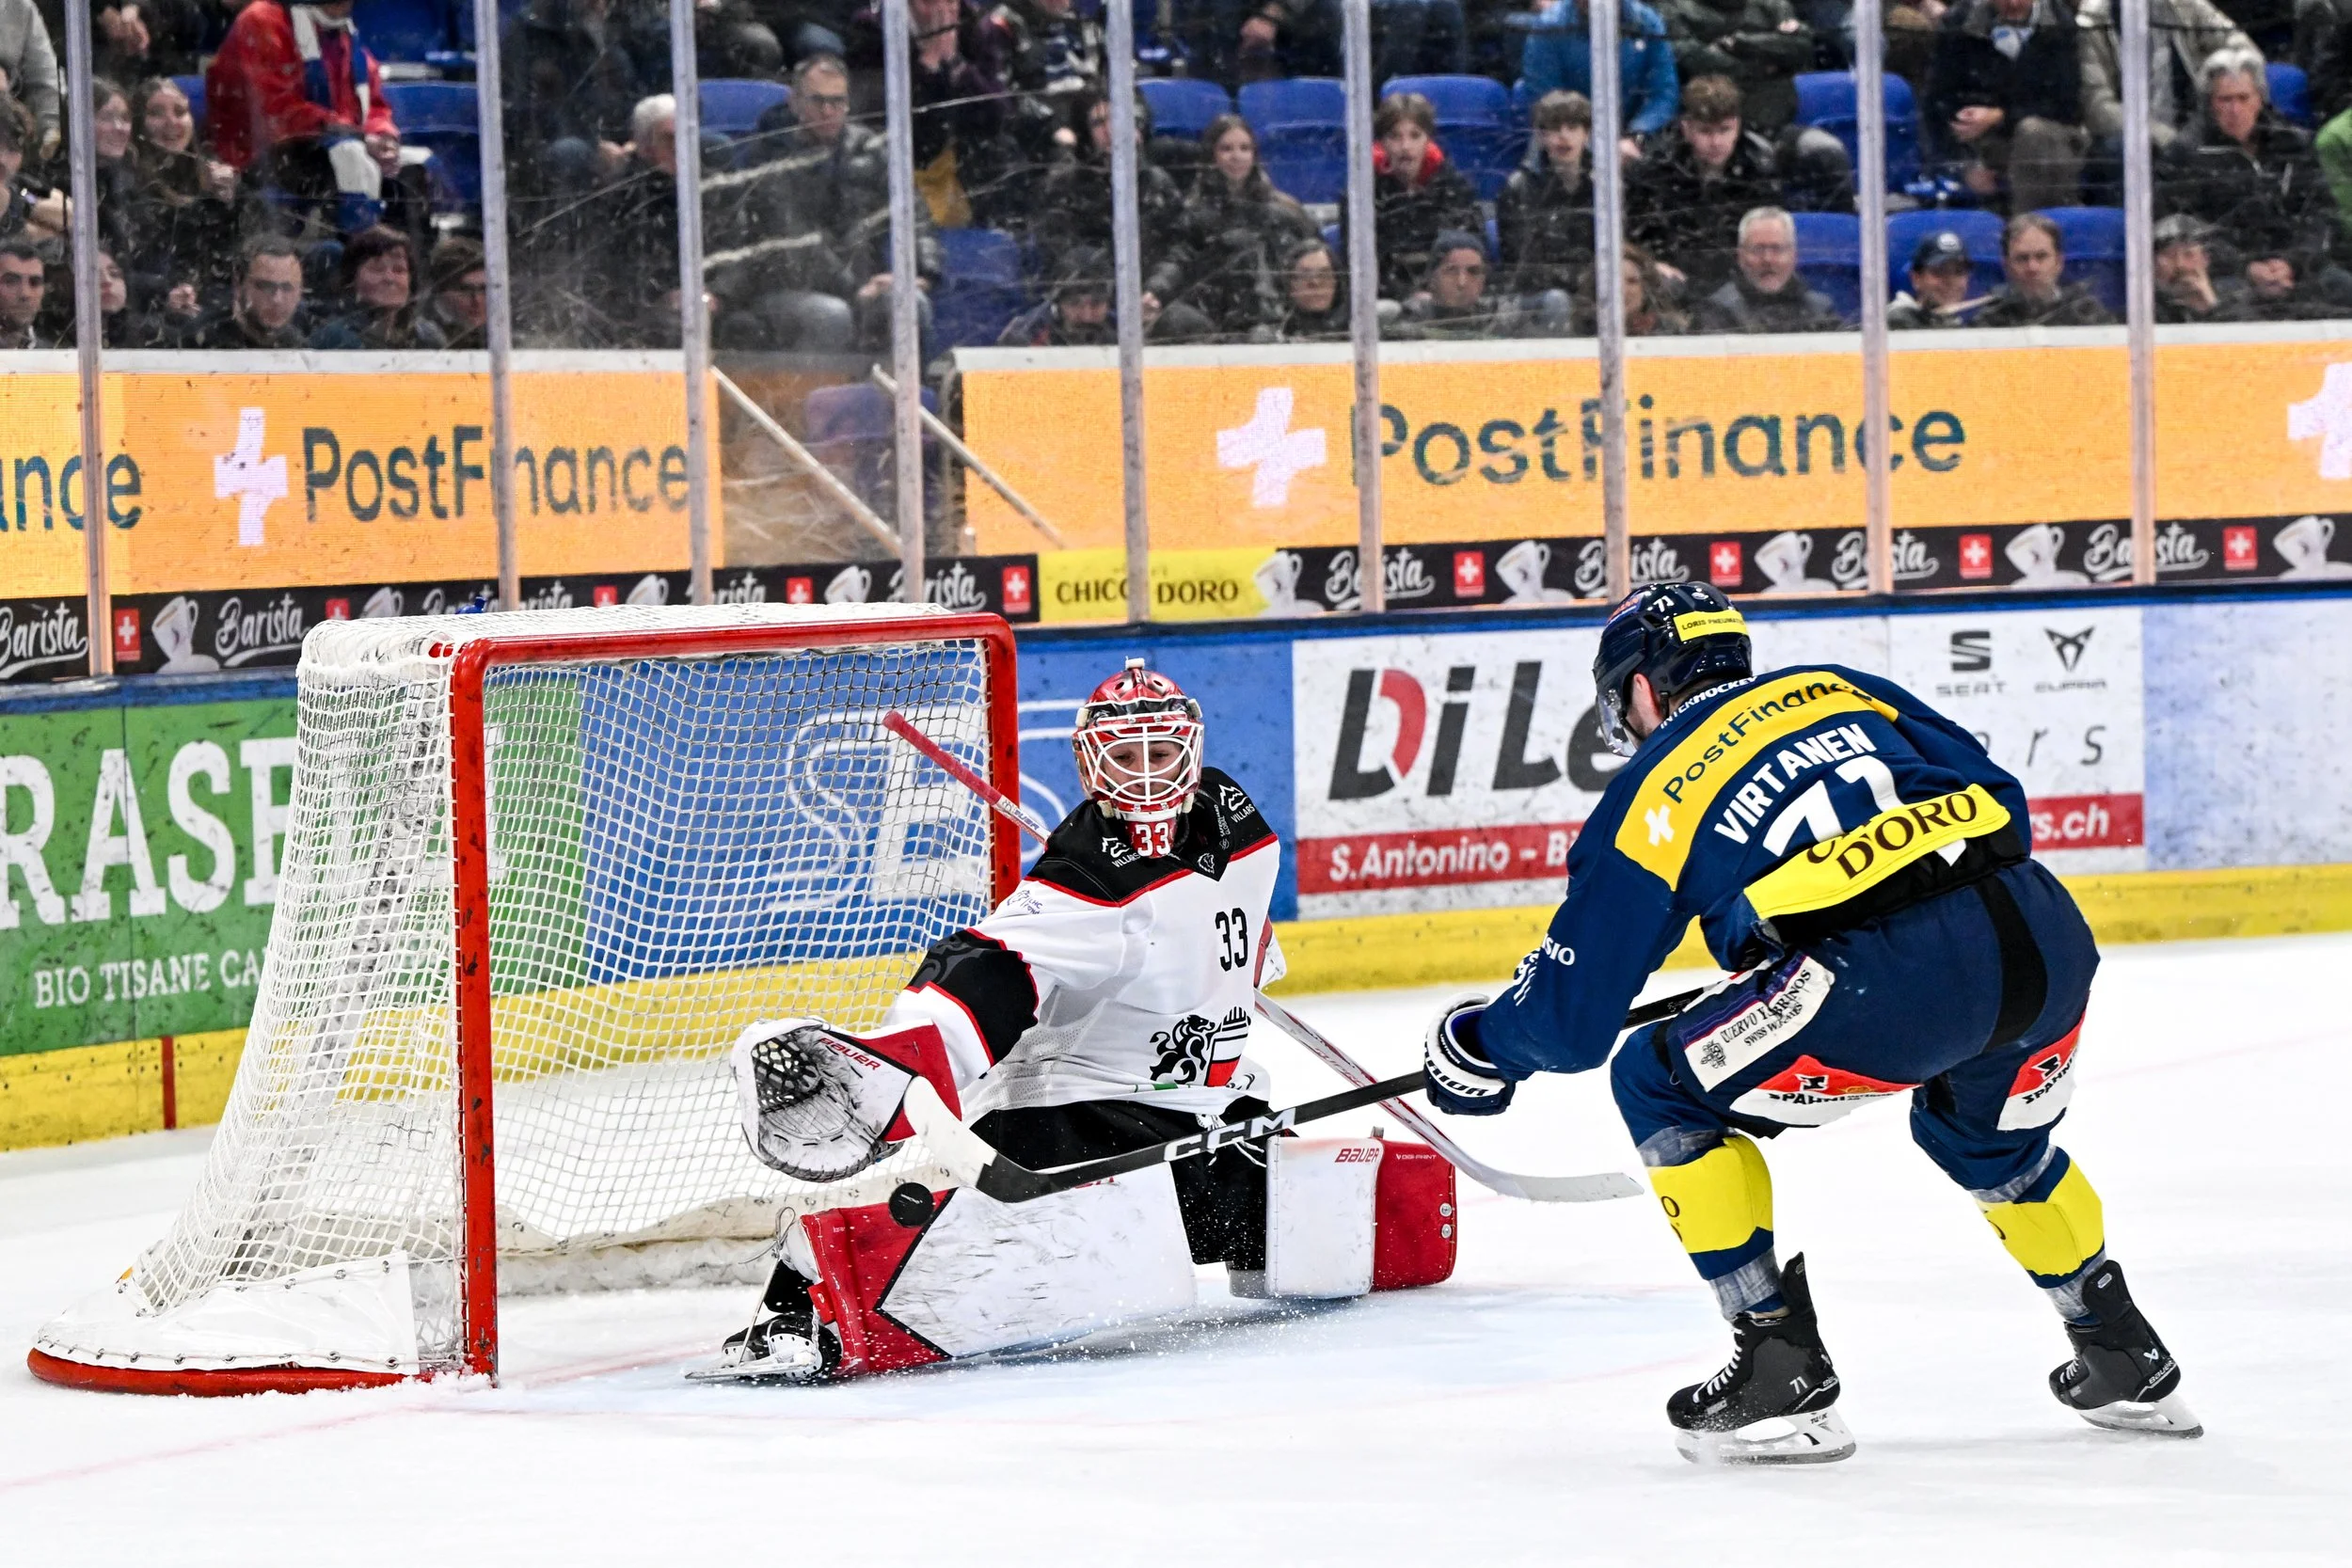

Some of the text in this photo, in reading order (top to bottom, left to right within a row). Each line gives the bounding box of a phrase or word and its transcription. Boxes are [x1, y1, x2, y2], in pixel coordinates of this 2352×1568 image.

[303, 424, 689, 524] PostFnance
[1653, 595, 1675, 612] 71
[1681, 619, 1707, 630] LORIS
[1714, 722, 1878, 845] VIRTANEN
[1230, 803, 1256, 823] VILLARS
[1135, 822, 1171, 857] 33
[1328, 836, 1510, 882] S.Antonino
[1215, 908, 1249, 972] 33
[35, 965, 91, 1009] BIO
[99, 952, 212, 1002] TISANE
[1164, 1108, 1296, 1162] CCM
[1789, 1376, 1808, 1395] 71
